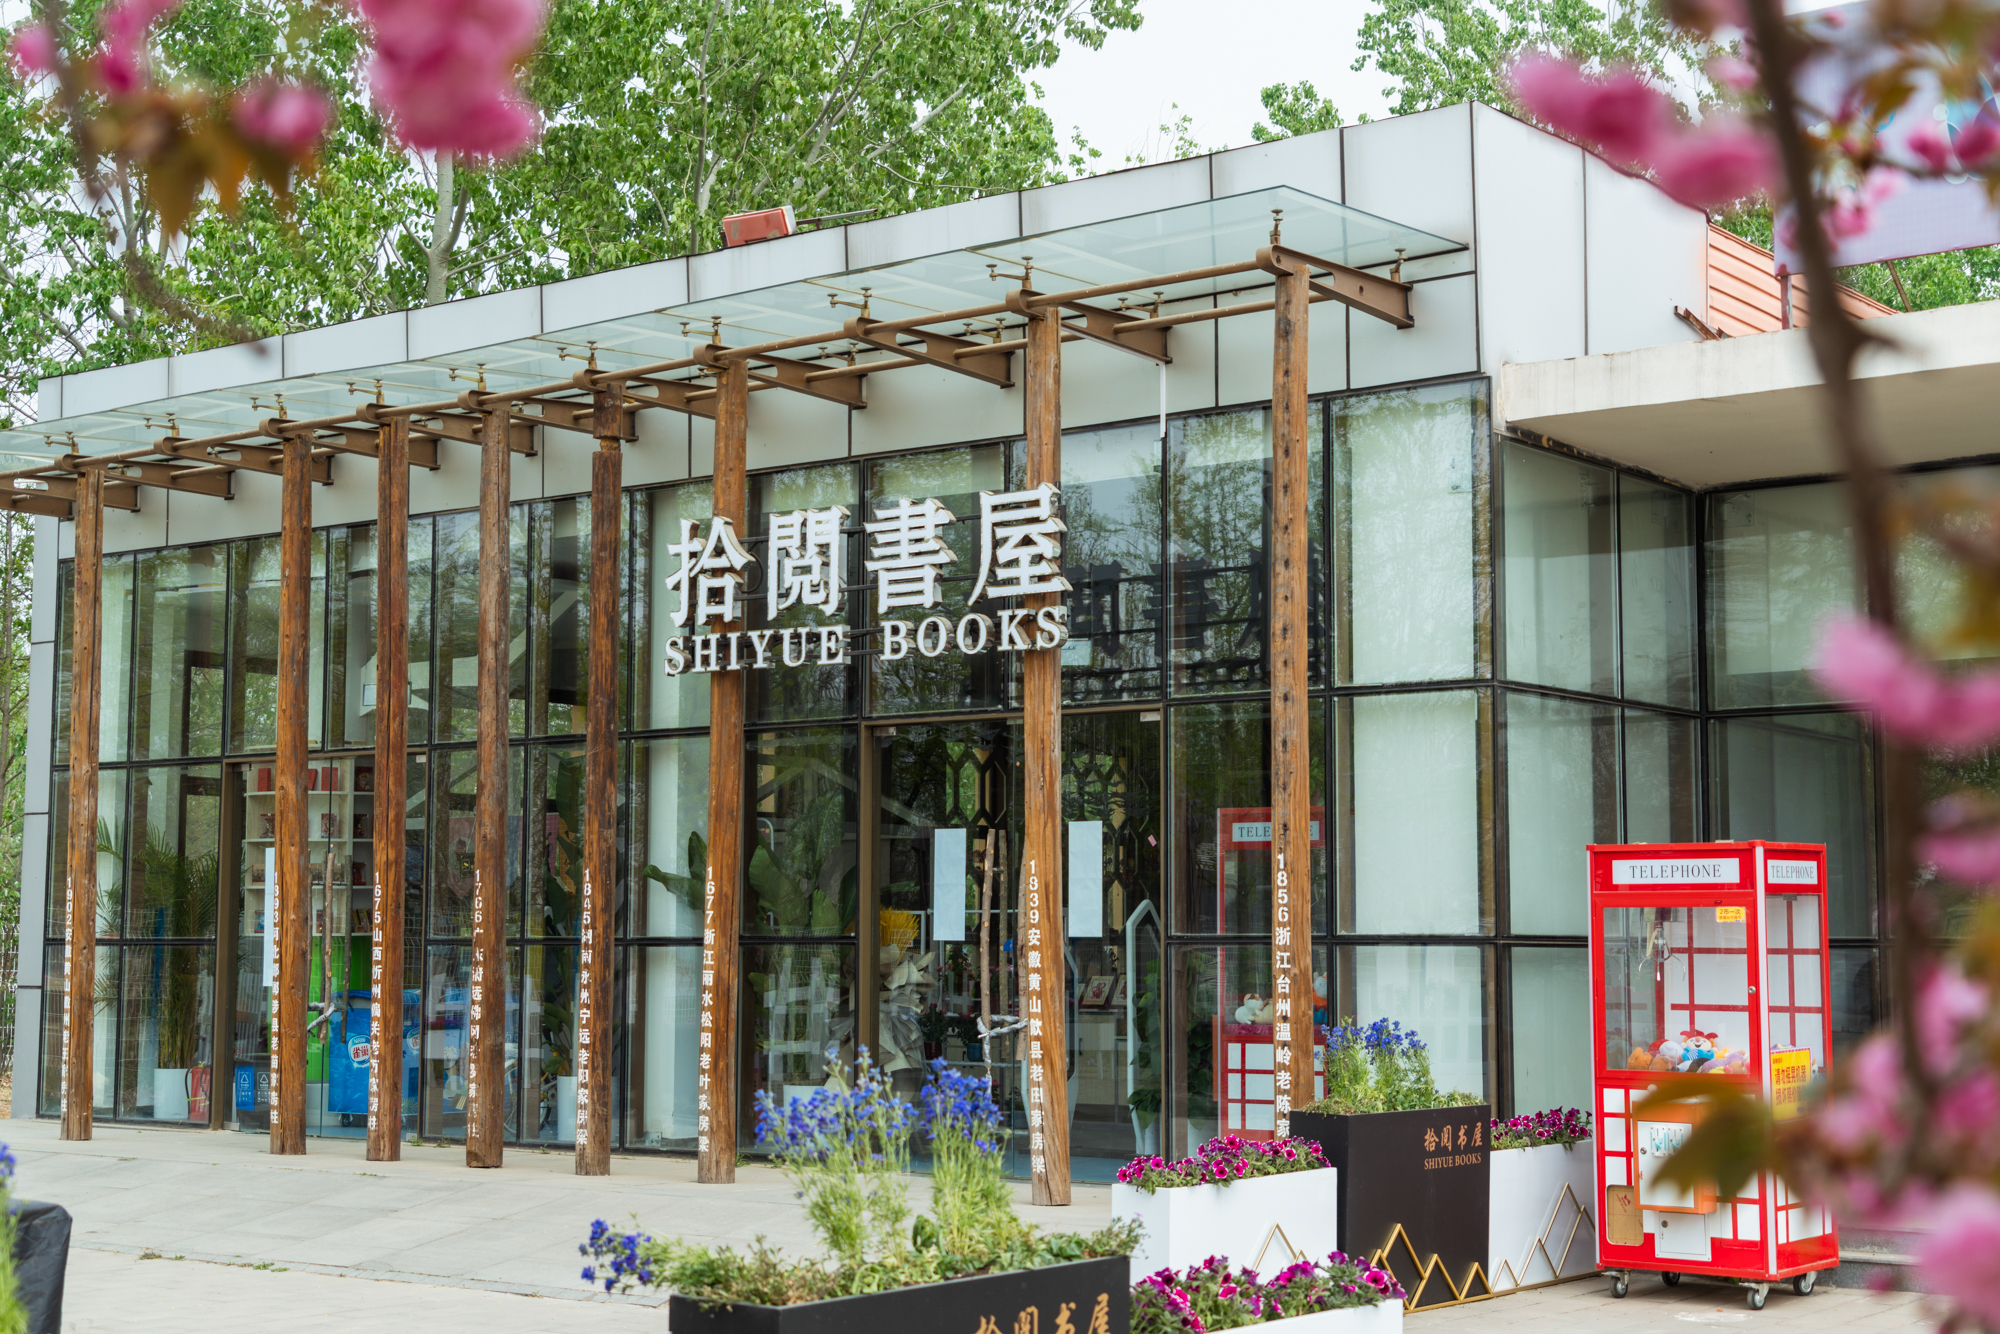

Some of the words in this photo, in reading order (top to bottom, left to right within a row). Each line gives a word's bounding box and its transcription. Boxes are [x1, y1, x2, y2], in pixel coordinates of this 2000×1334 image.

[664, 624, 850, 676] SHIYUE
[880, 605, 1068, 661] BOOKS
[1629, 864, 1722, 879] TELEPHONE
[1771, 865, 1815, 879] TELEPHONE
[1424, 1156, 1453, 1170] SHIYUE
[1455, 1153, 1482, 1166] BOOKS
